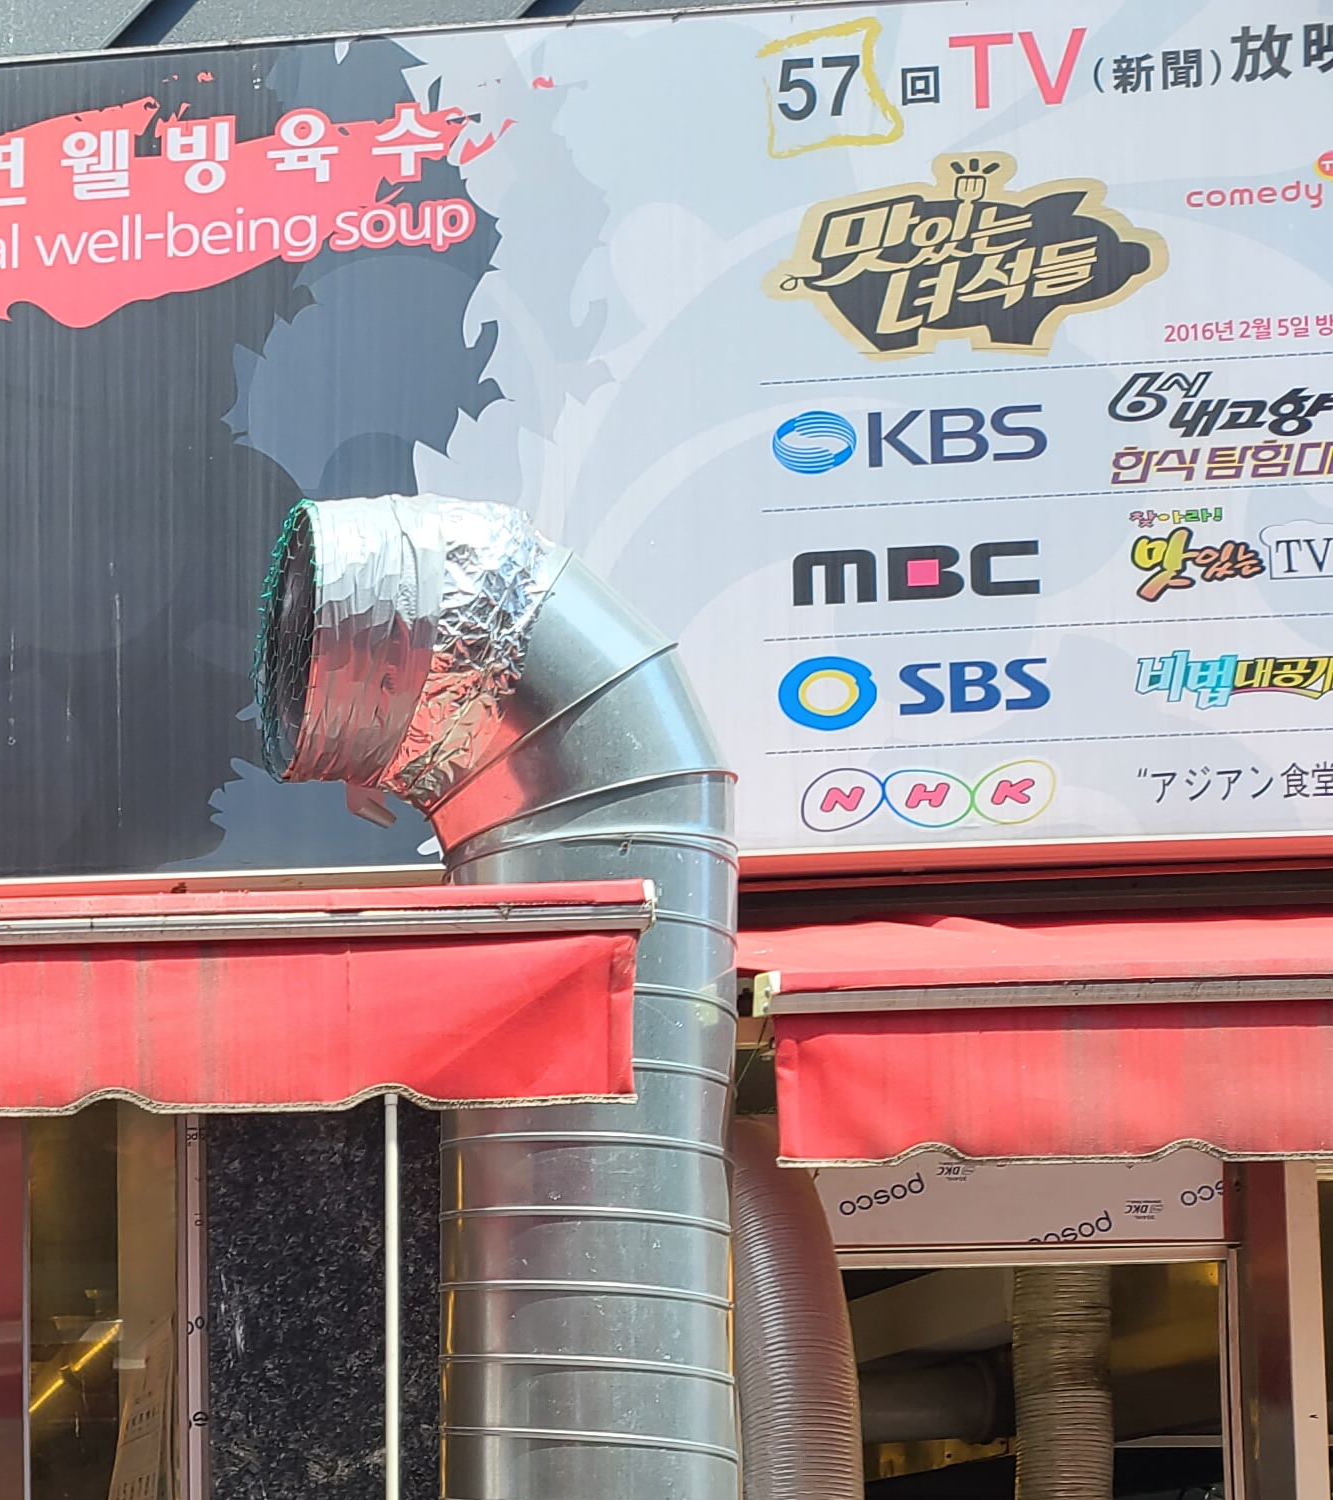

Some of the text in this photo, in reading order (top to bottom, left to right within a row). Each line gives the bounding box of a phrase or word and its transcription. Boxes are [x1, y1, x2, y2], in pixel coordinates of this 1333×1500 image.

[777, 54, 861, 122] 57
[900, 66, 941, 107] 回
[948, 27, 1088, 110] TV
[1185, 179, 1324, 209] comedy
[36, 206, 321, 273] well-being
[333, 198, 472, 253] soup
[812, 193, 1034, 287] 맛있는
[875, 234, 1099, 335] 녀석들
[1163, 313, 1333, 343] 2016년 2월 5일 방
[867, 404, 1049, 469] KBS
[1110, 445, 1202, 485] 한식
[791, 539, 1042, 607] MBC
[1274, 536, 1333, 575] TV
[898, 656, 1052, 717] SBS
[838, 1171, 926, 1217] posco
